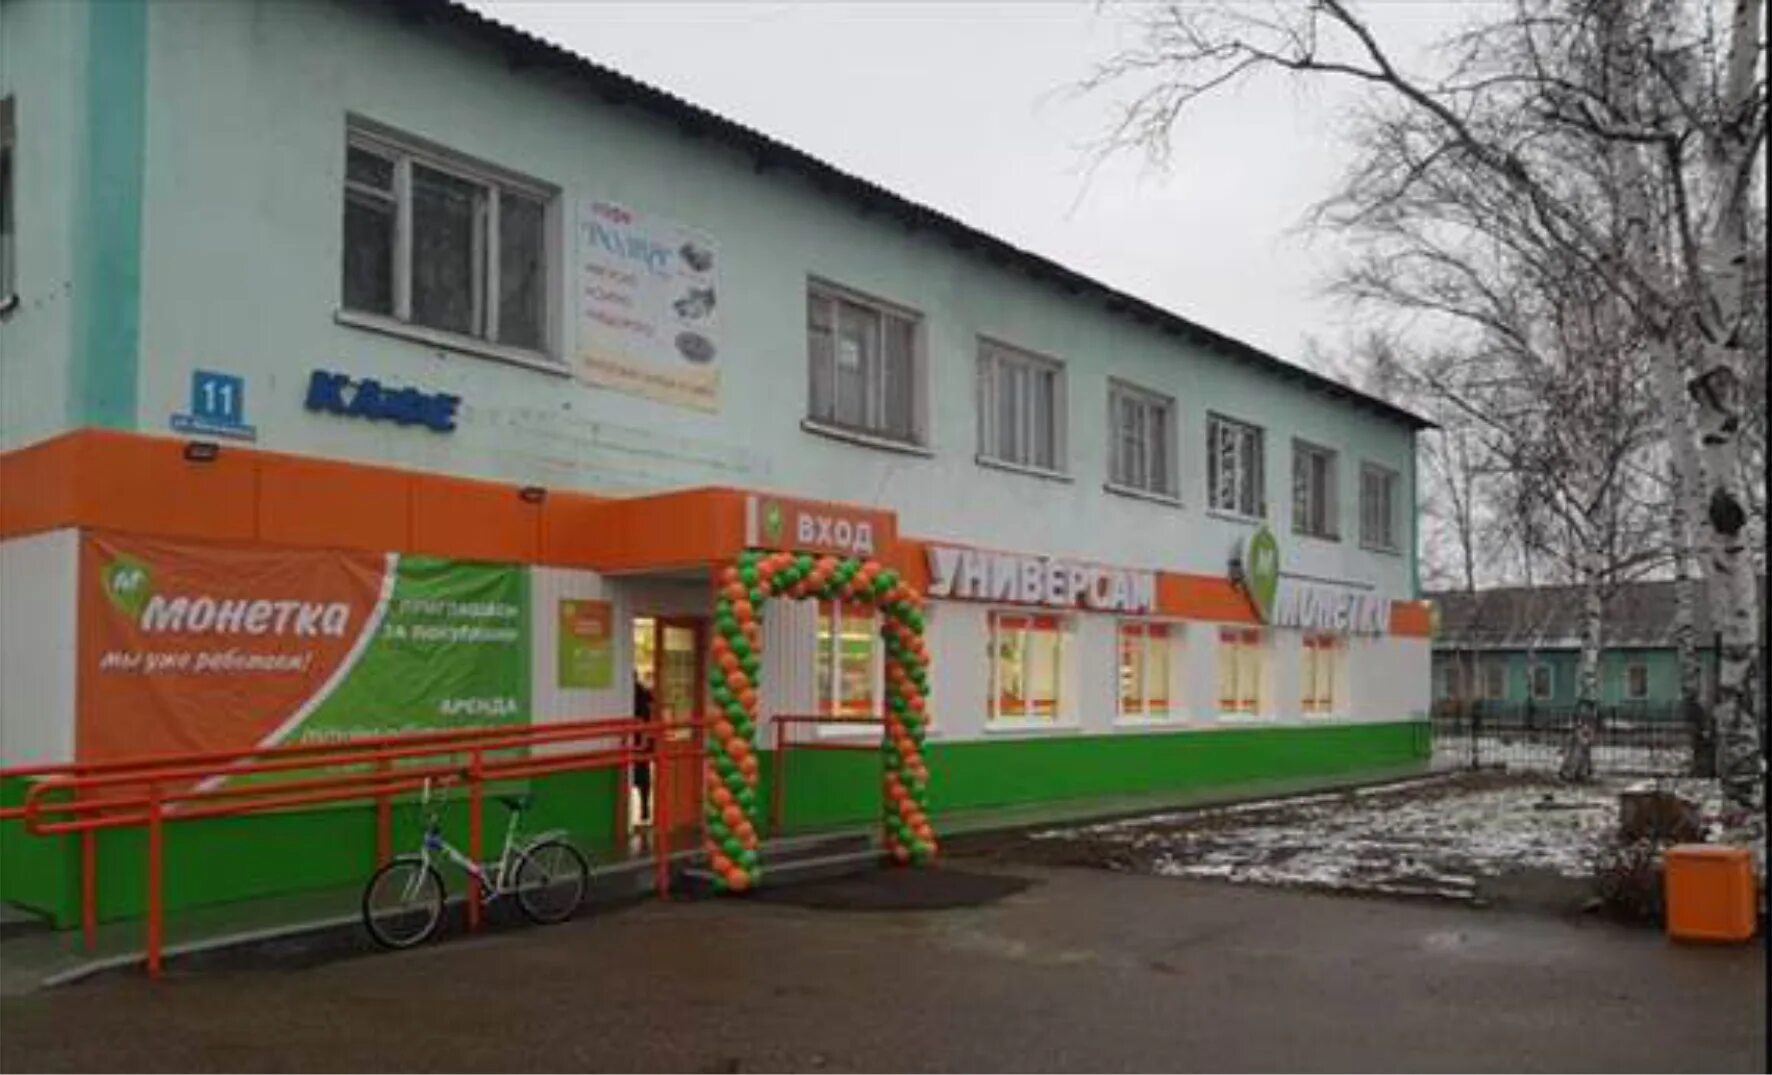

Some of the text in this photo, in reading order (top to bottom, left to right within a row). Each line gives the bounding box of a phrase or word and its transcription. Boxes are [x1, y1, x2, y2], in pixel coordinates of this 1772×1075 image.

[202, 380, 233, 416] 11
[797, 511, 873, 556] ВХОД
[927, 546, 1157, 614] УНИВЕРСАМ
[143, 651, 191, 674] уже
[440, 698, 518, 716] АРЕНДА
